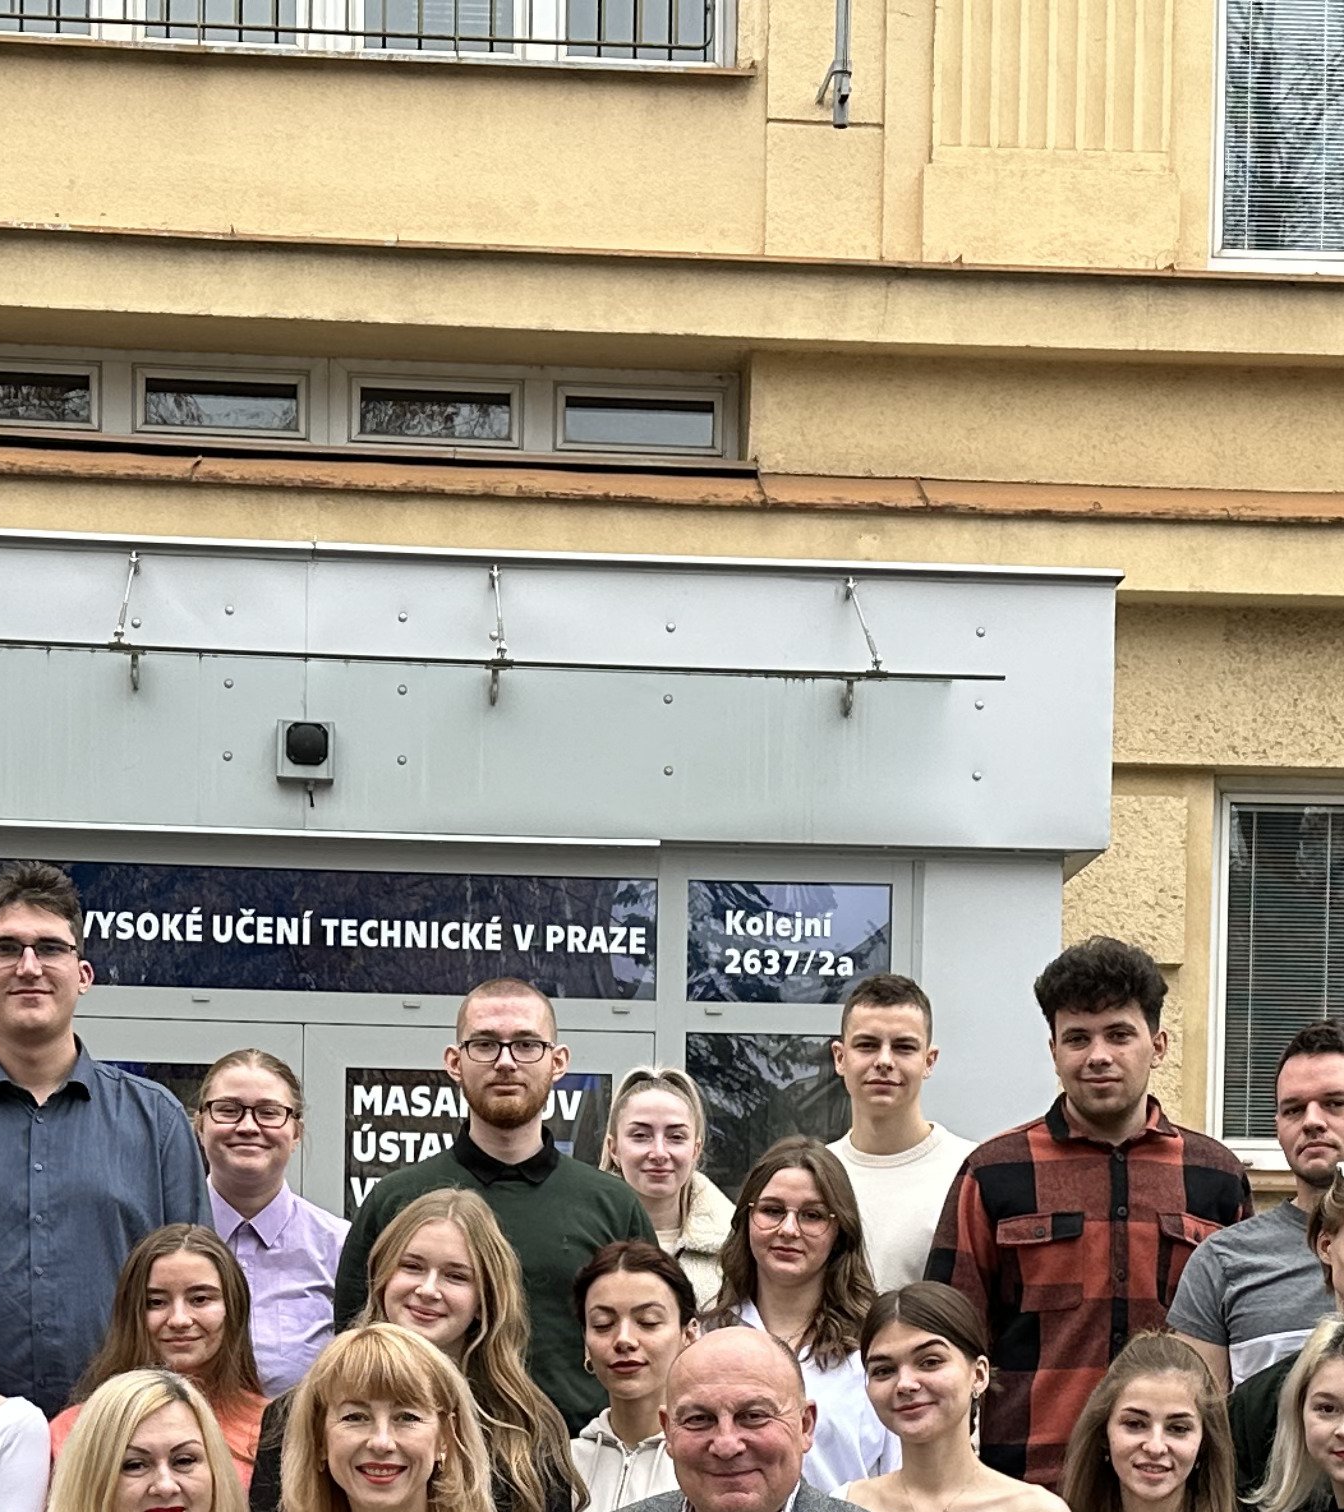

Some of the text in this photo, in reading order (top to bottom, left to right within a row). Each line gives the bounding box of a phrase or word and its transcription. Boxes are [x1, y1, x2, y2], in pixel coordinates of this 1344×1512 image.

[212, 908, 315, 946] UČENÍ
[321, 916, 502, 950] TECHNICKÉ
[513, 924, 535, 951] V
[546, 925, 646, 955] PRAZE
[725, 909, 833, 943] Kolejní
[724, 948, 854, 977] 2637/2a
